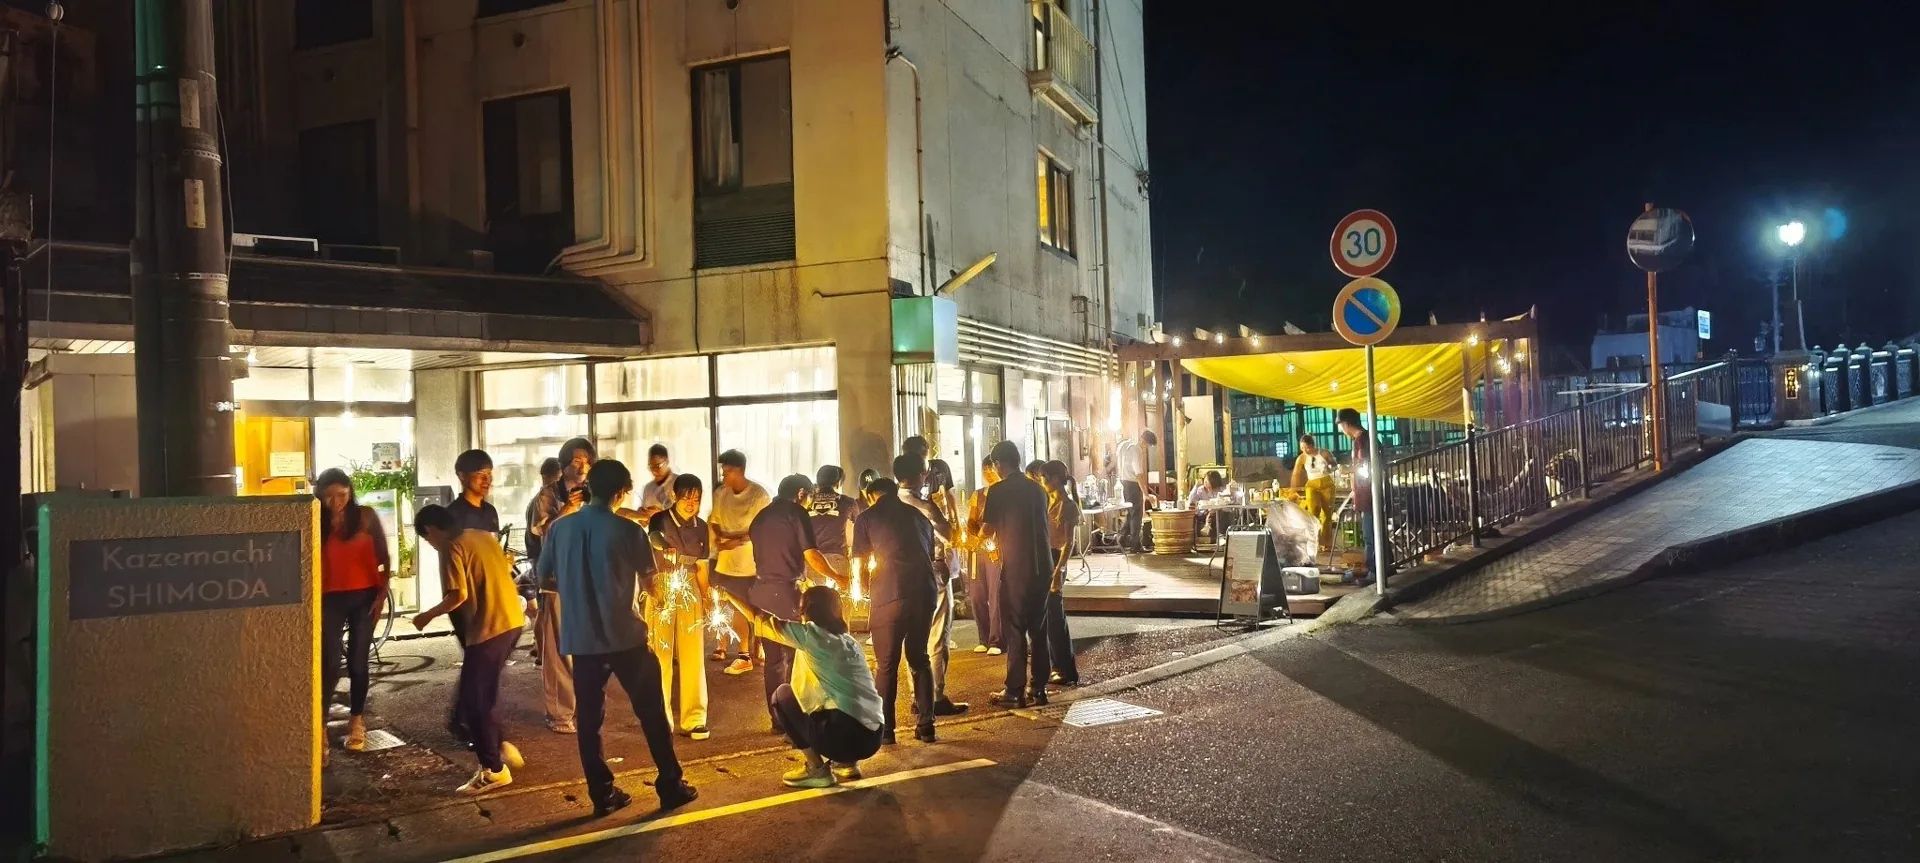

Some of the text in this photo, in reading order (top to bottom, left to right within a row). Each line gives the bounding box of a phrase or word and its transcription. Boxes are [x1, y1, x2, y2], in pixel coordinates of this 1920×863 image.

[1347, 227, 1381, 258] 30
[102, 539, 273, 571] Kazemachi
[107, 578, 270, 608] SHIMODA
